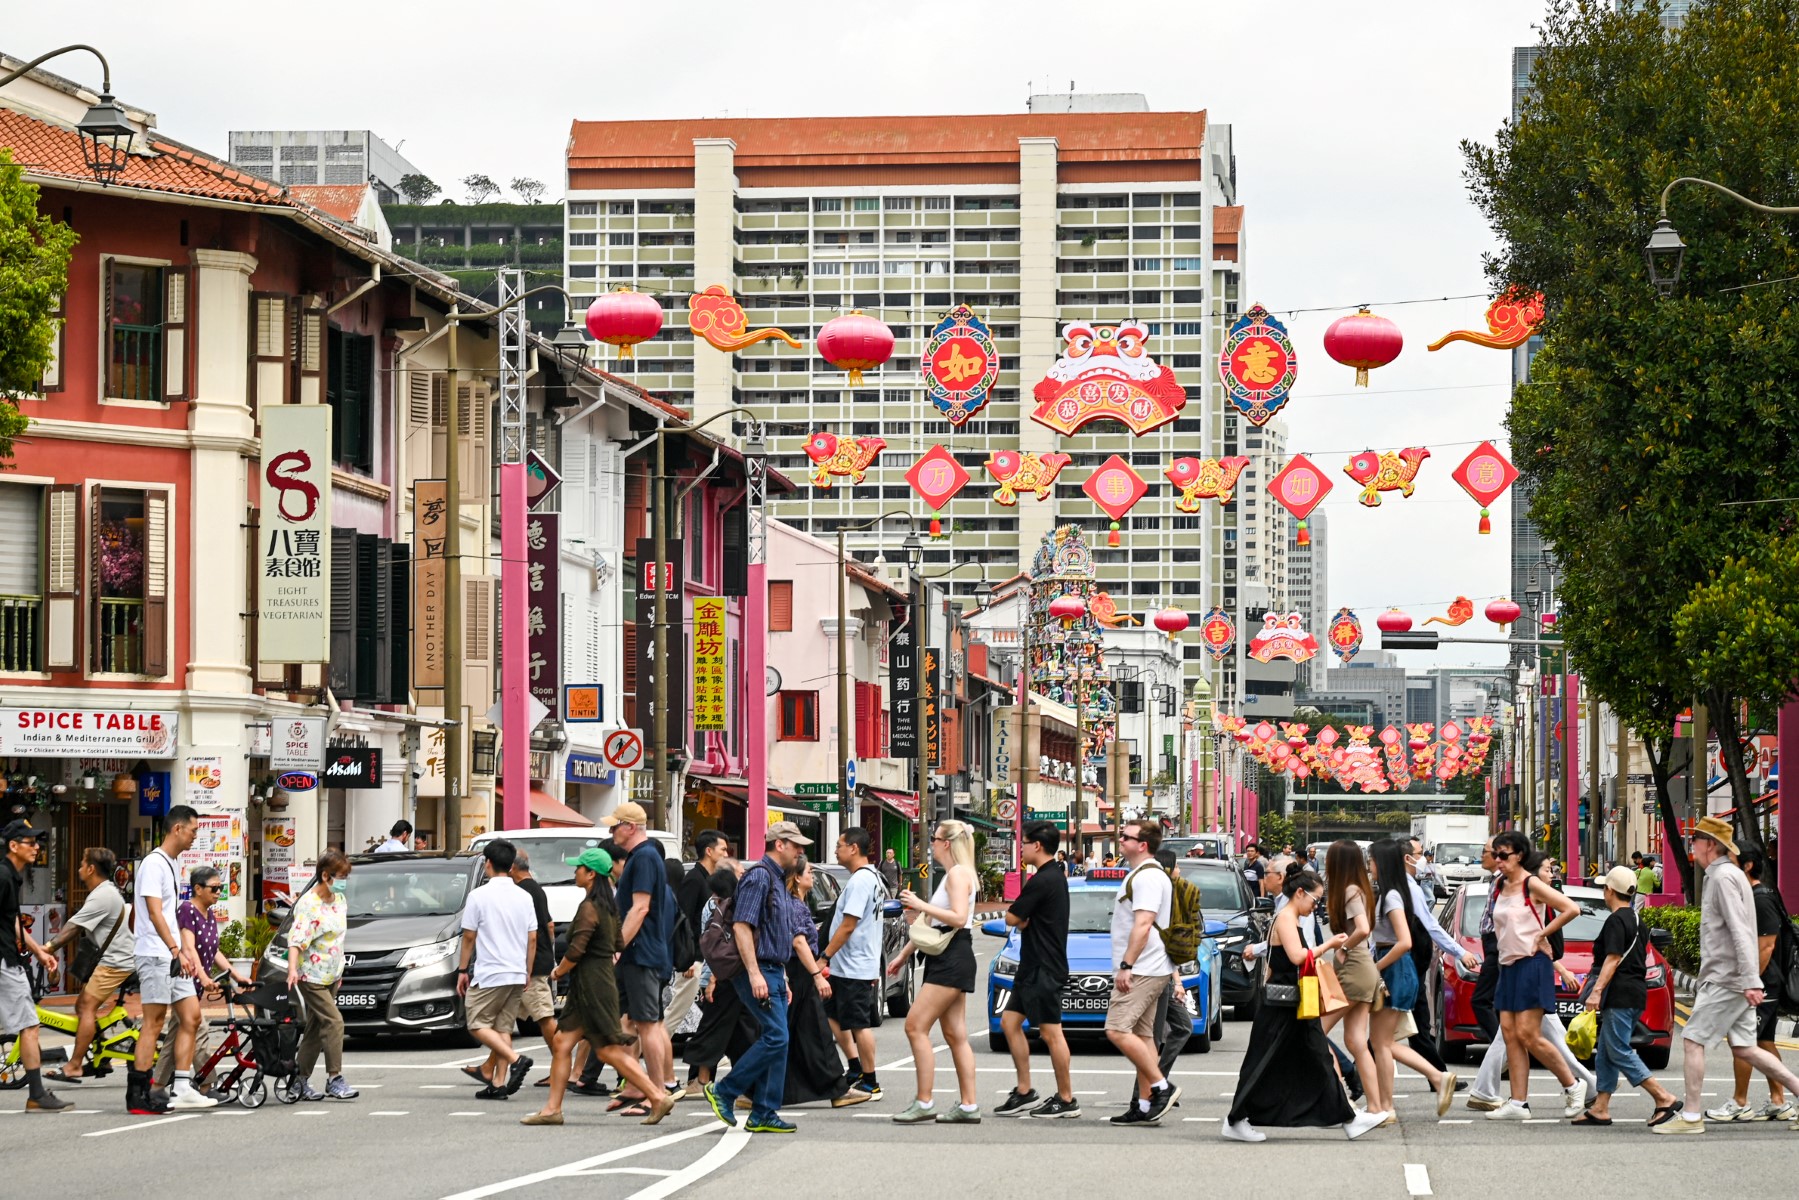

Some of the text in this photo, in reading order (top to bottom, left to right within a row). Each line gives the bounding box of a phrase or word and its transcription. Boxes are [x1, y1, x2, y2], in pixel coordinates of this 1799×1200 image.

[939, 344, 983, 382] 如
[1238, 341, 1279, 384] 意
[1475, 461, 1497, 484] 意
[1106, 475, 1126, 499] 事
[1290, 475, 1311, 496] 如
[267, 529, 320, 556] 八寶
[265, 558, 321, 577] 素食馆
[278, 587, 308, 595] EIGHT
[267, 599, 319, 607] TREASURES
[263, 612, 323, 620] VEGETARIAN
[426, 571, 435, 671] ANOTHER DAY
[1209, 622, 1226, 642] 吉
[1335, 624, 1355, 644] 祥
[896, 632, 910, 714] 泰山药行
[18, 712, 161, 730] SPICE TABLE
[996, 720, 1009, 781] TAILORS
[326, 762, 362, 776] Asahi
[280, 778, 312, 788] OPEN
[800, 784, 832, 793] Smith
[144, 788, 160, 802] Tiger
[1094, 870, 1124, 878] HIRED
